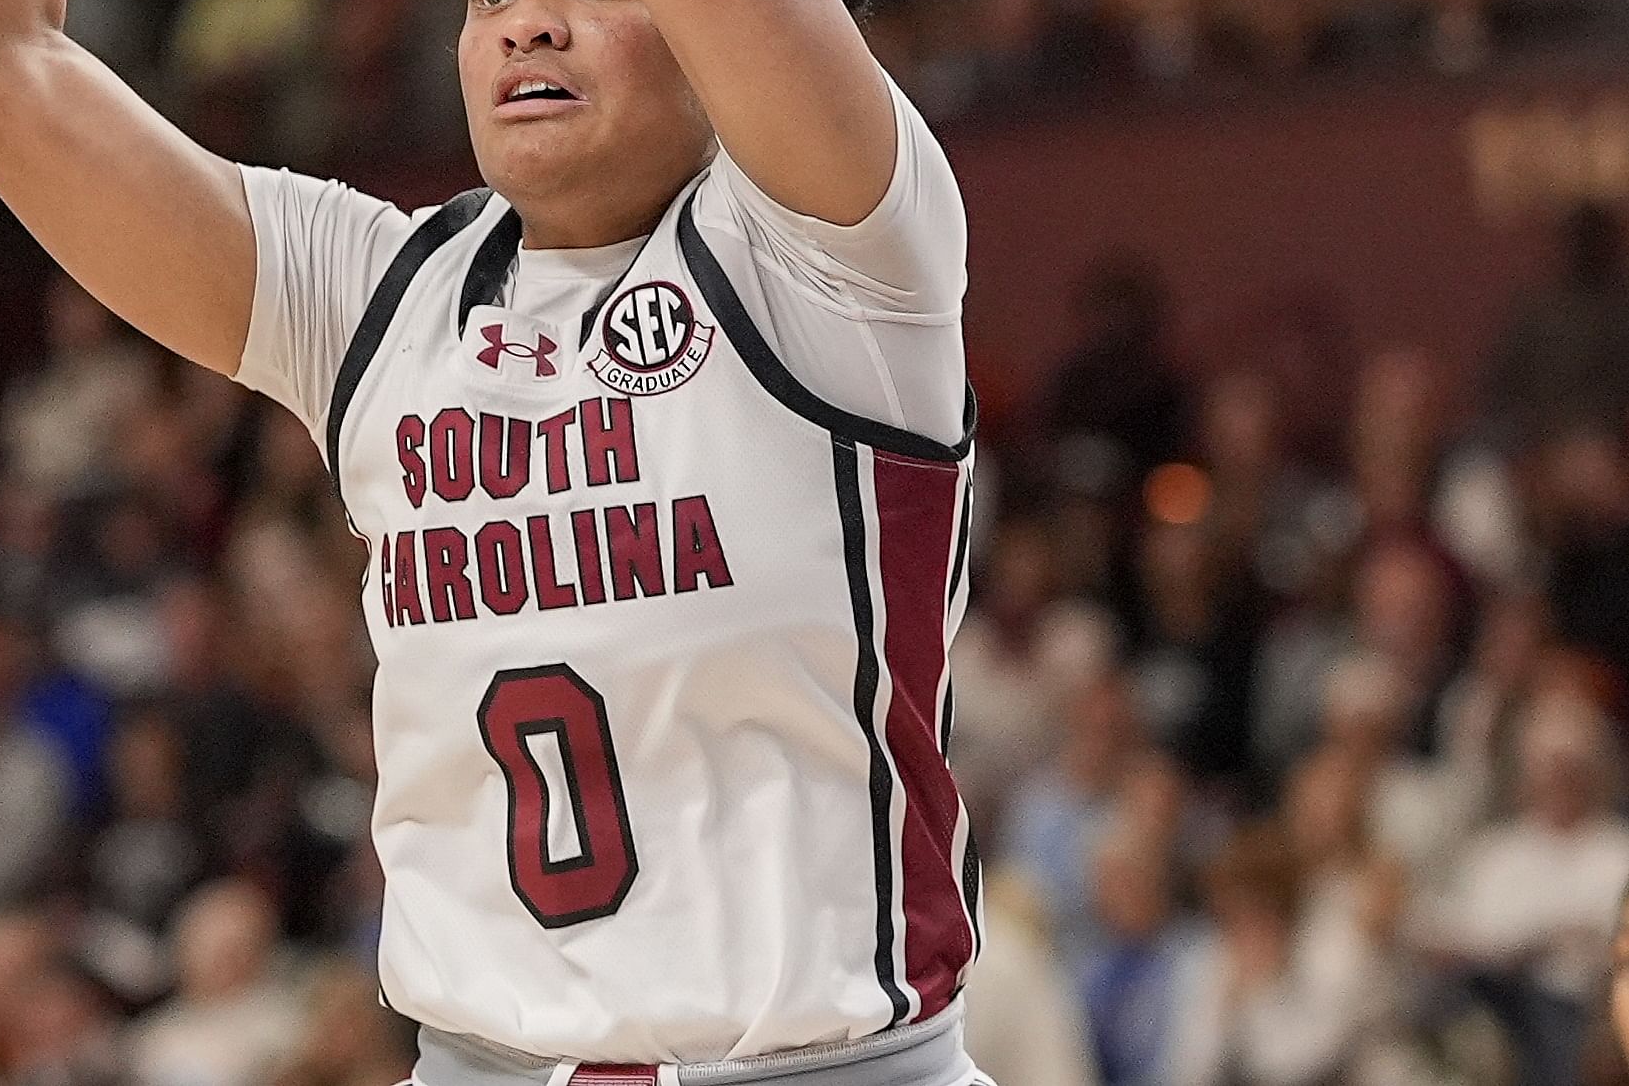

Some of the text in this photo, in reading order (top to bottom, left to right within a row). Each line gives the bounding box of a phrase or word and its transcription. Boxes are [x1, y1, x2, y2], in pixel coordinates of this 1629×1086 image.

[607, 347, 702, 393] GRADUATE
[609, 285, 686, 367] SEC
[396, 396, 640, 509] SOUTH
[381, 495, 735, 628] CAROLINA
[477, 662, 639, 929] 0
